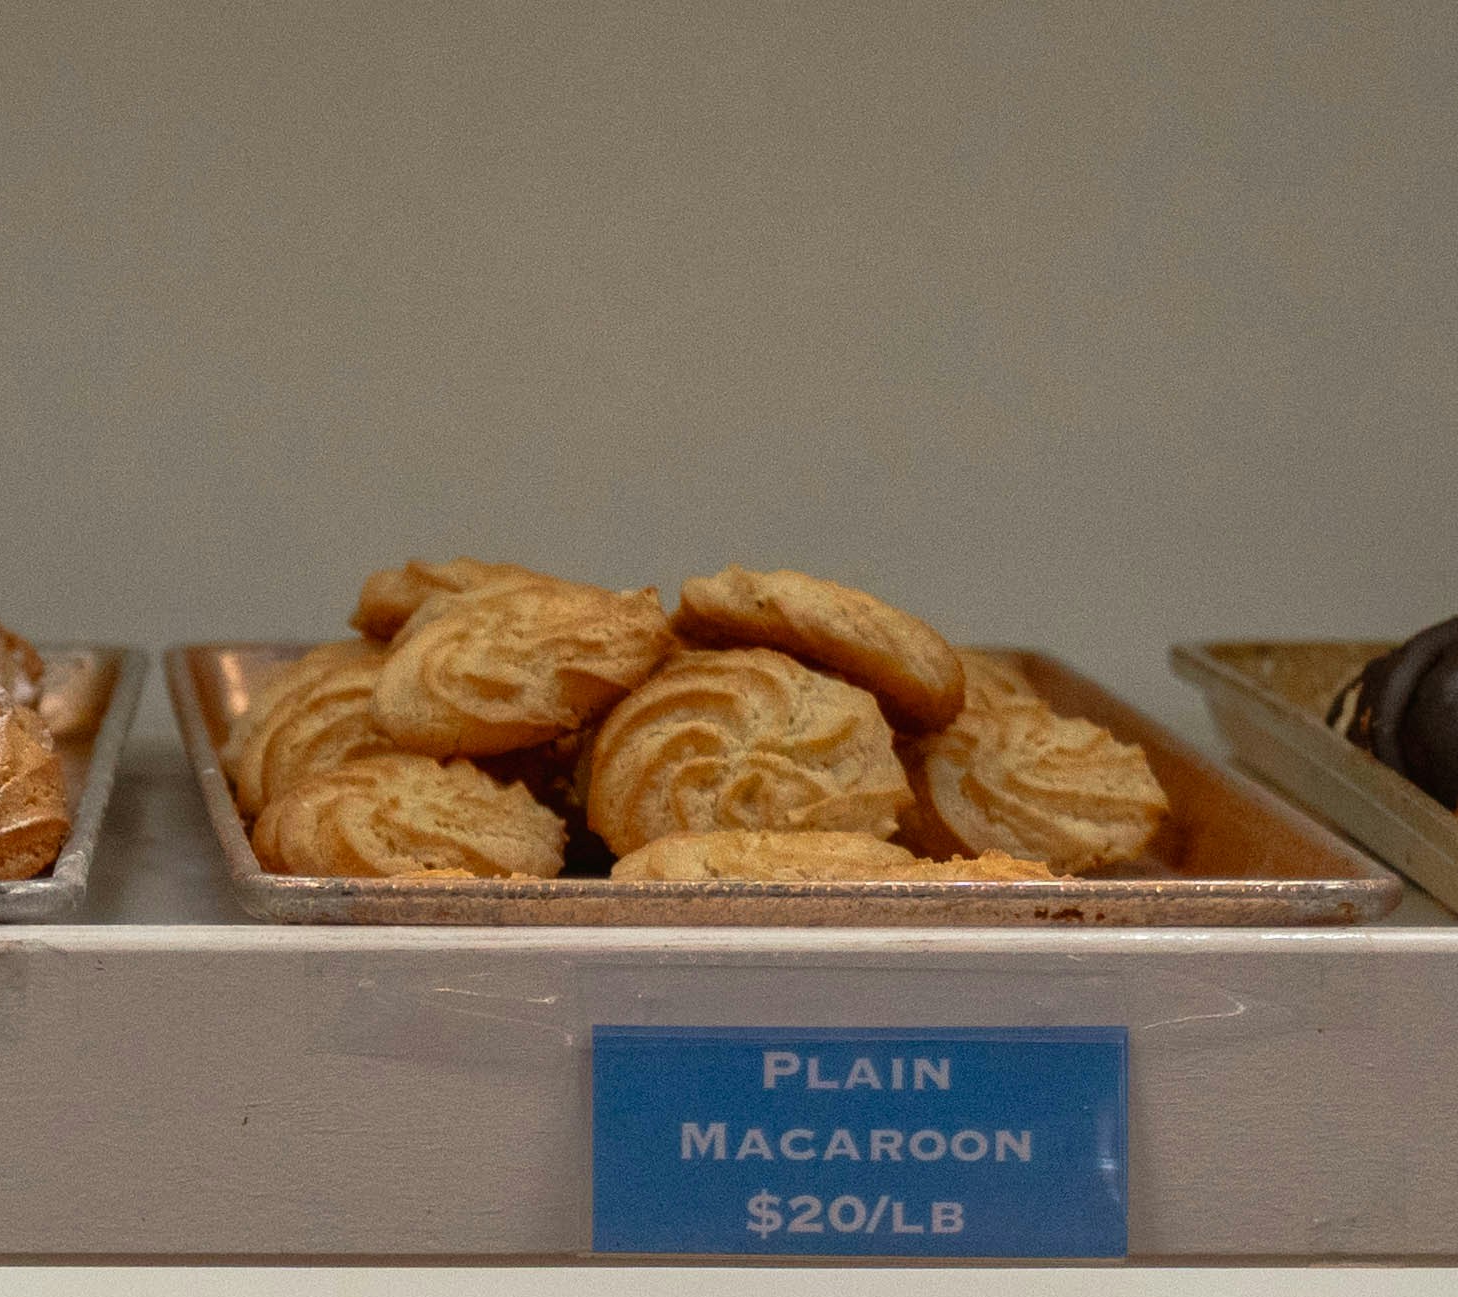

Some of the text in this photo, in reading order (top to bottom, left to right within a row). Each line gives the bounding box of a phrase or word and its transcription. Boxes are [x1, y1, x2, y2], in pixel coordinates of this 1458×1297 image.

[763, 1050, 951, 1090] PLAIN
[680, 1121, 1032, 1163] MACAROON
[746, 1190, 965, 1239] $20/LB
